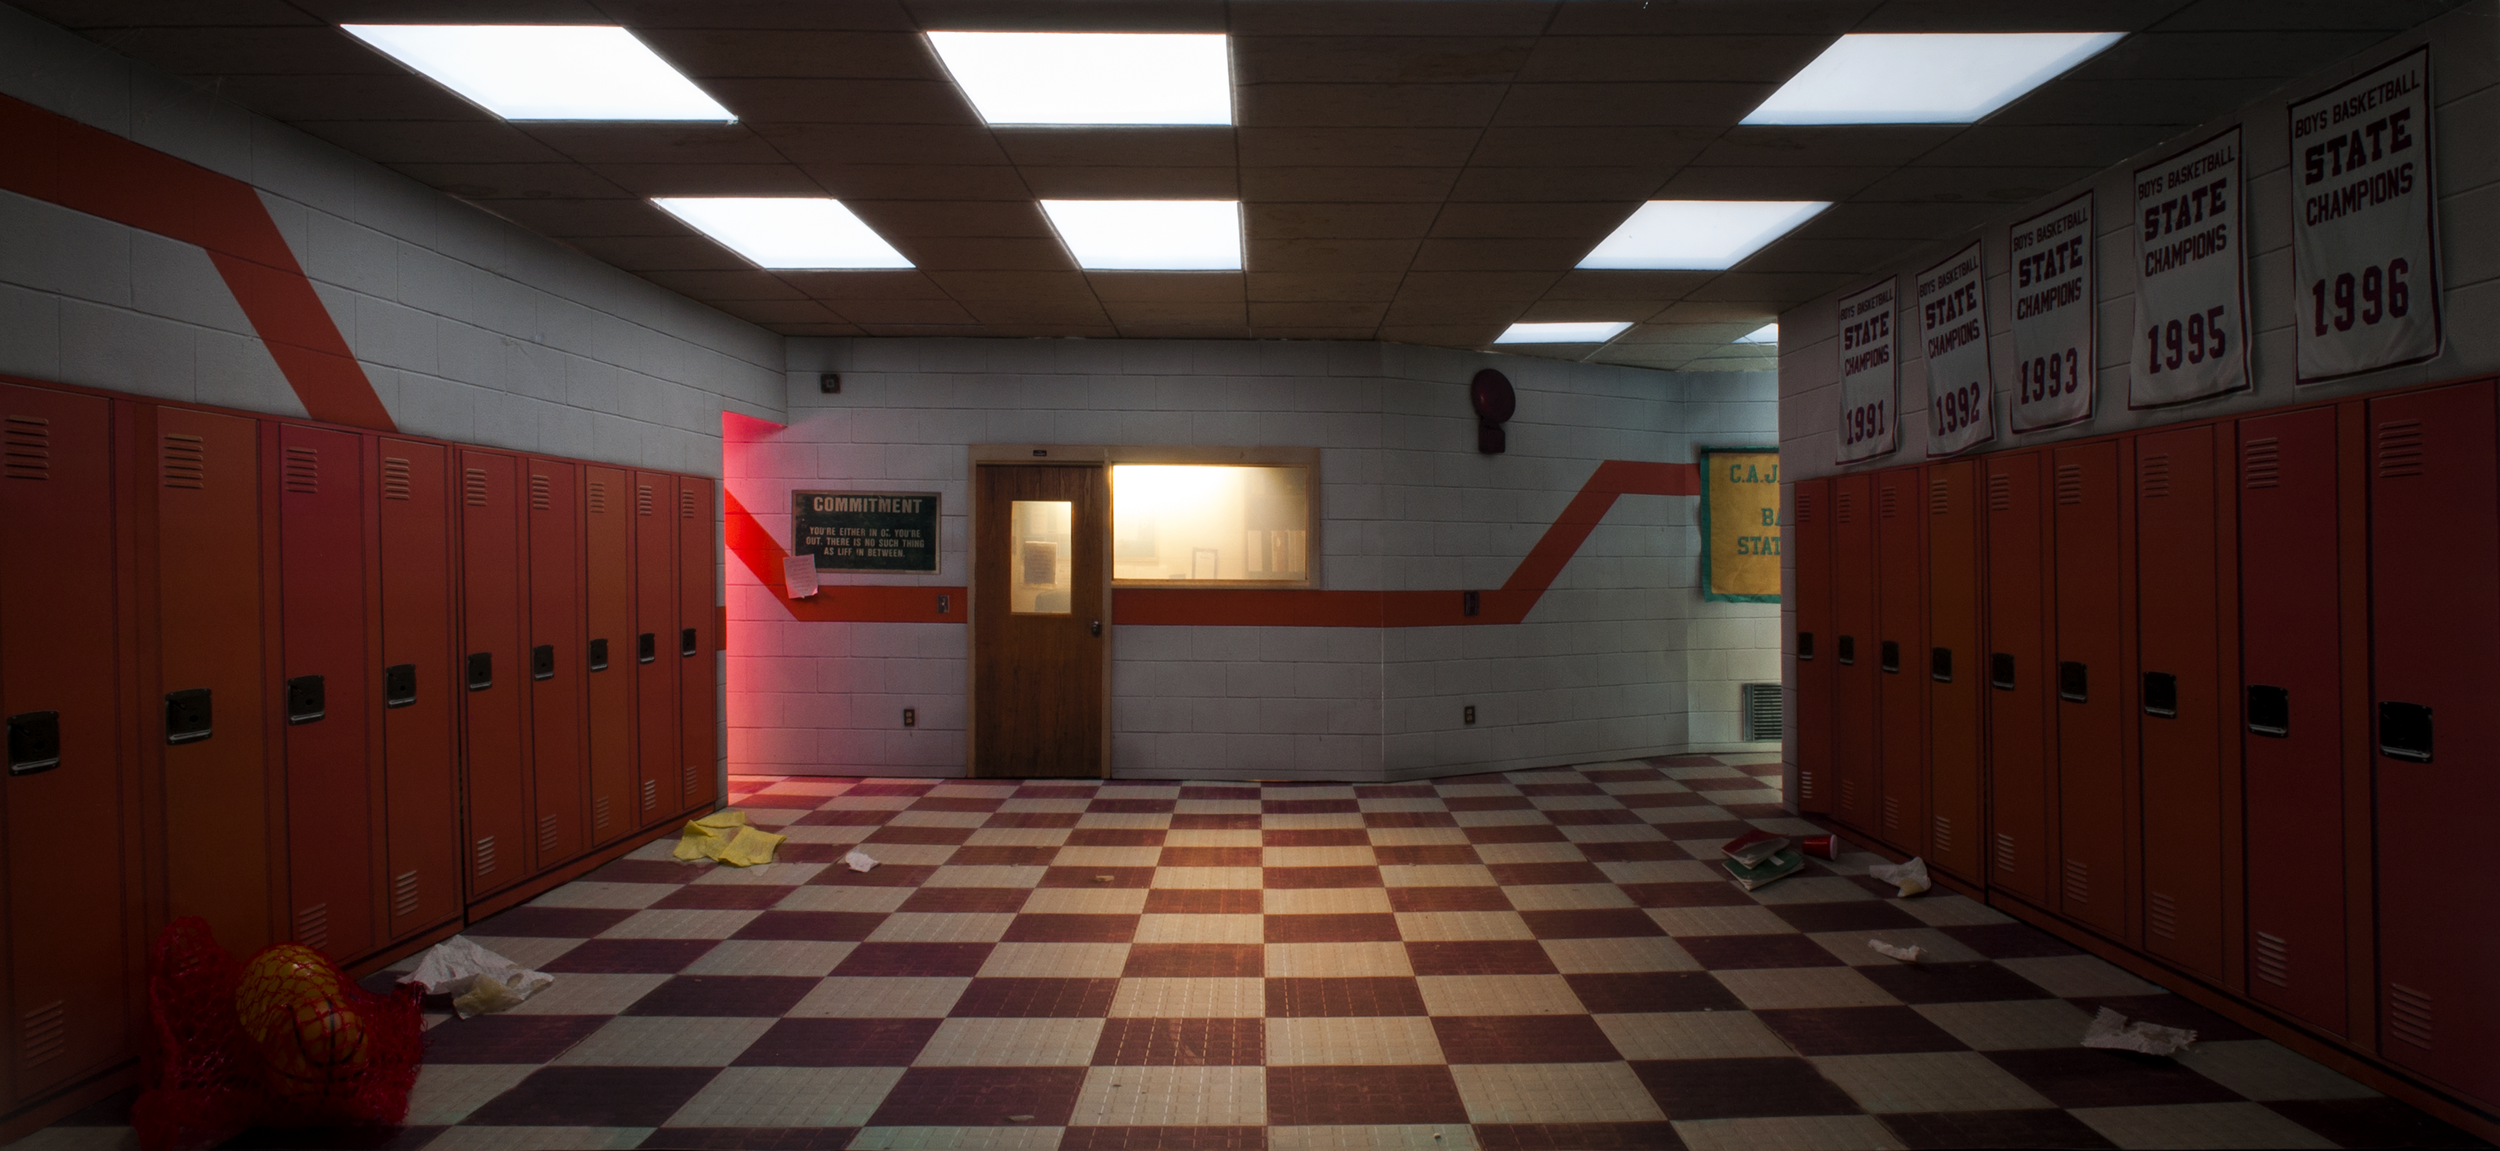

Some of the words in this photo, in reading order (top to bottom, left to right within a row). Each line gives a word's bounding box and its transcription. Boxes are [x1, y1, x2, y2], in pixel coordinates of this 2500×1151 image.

[2295, 109, 2328, 138] BOYS
[2333, 69, 2420, 125] BASKETBALL
[2305, 107, 2412, 186] STATE
[2138, 176, 2163, 200] BOYS
[2168, 146, 2235, 189] BASKETBALL
[2306, 162, 2414, 227] CHAMPIONS
[2013, 231, 2033, 252] BOYS
[2036, 207, 2088, 243] BASKETBALL
[2144, 177, 2227, 242] STATE
[2019, 235, 2083, 288] STATE
[2145, 223, 2227, 278] CHAMPIONS
[1919, 280, 1935, 298] BOYS
[1938, 256, 1979, 289] BASKETBALL
[2017, 277, 2082, 320] CHAMPIONS
[2312, 257, 2409, 337] 1996
[1840, 302, 1855, 321] BOYS
[1857, 288, 1893, 315] BASKETBALL
[1925, 280, 1977, 331] STATE
[1844, 310, 1889, 350] STATE
[1928, 318, 1980, 359] CHAMPIONS
[2148, 305, 2225, 374] 1995
[1844, 344, 1889, 377] CHAMPIONS
[2021, 347, 2078, 405] 1993
[1846, 399, 1884, 445] 1991
[1936, 381, 1980, 436] 1992
[813, 496, 923, 514] COMMITMENT
[805, 536, 823, 546] OUT.
[826, 537, 850, 547] THERE
[853, 538, 861, 547] IS
[864, 538, 875, 547] NO
[878, 538, 899, 548] SUCH
[901, 539, 925, 548] THING
[809, 526, 836, 536] YOU'RE
[839, 527, 866, 537] EITHER
[869, 528, 878, 537] IN
[894, 528, 921, 538] YOU'RE
[823, 547, 834, 556] AS
[856, 548, 864, 557] IN
[867, 548, 906, 558] BETWEEN.
